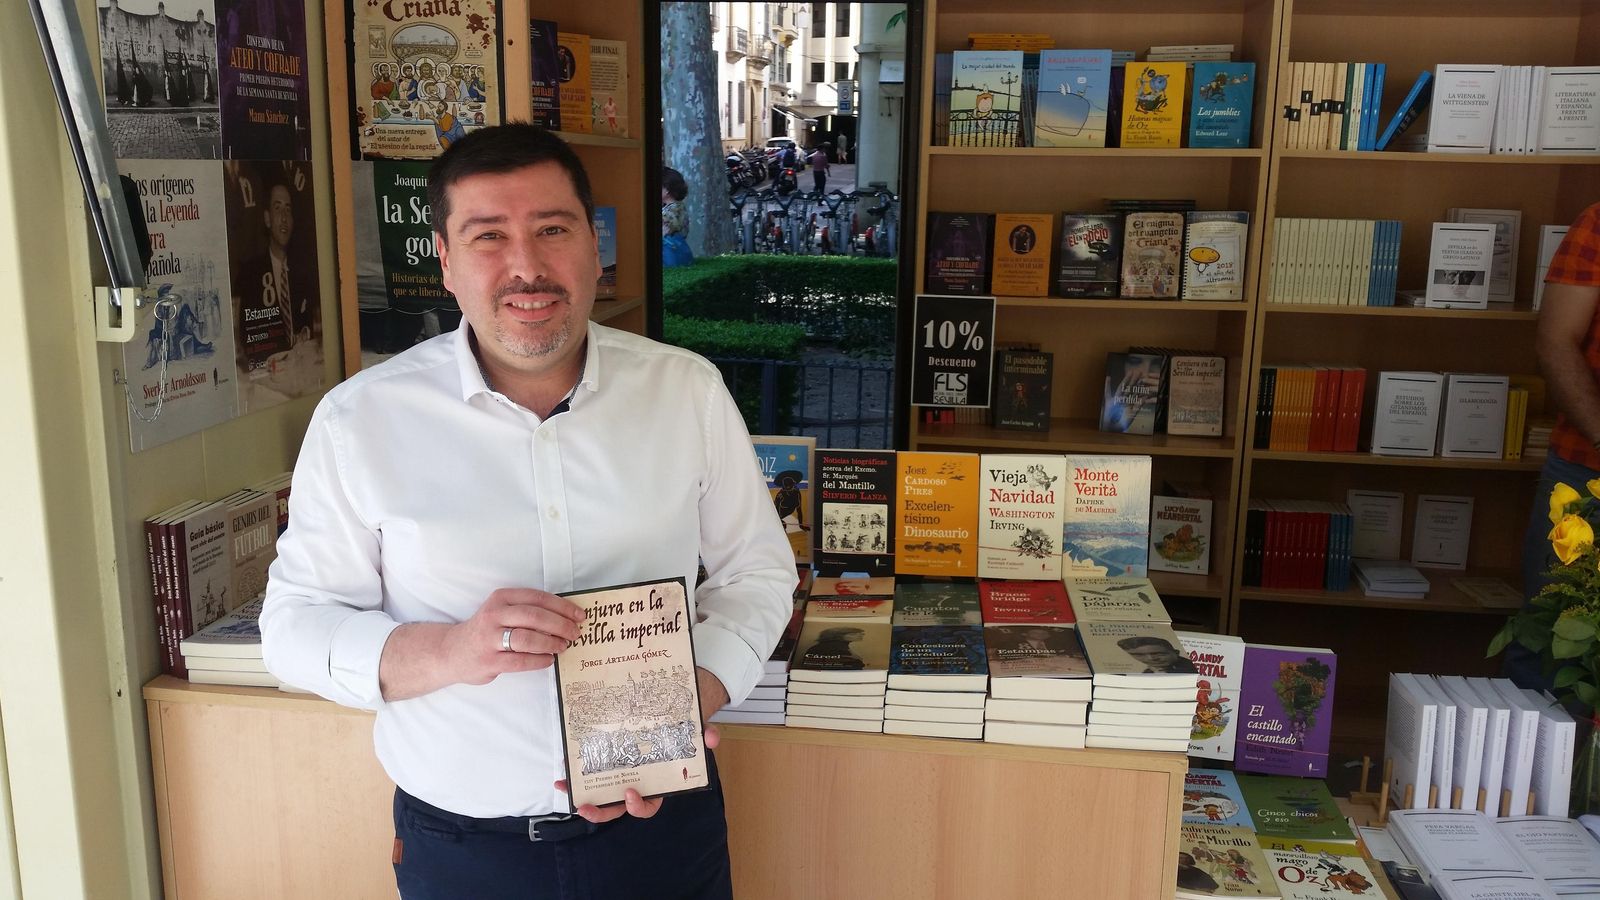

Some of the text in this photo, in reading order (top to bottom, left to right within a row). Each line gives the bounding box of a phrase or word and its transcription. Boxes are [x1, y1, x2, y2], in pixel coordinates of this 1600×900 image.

[230, 47, 254, 70] ATEO
[256, 49, 262, 71] Y
[264, 51, 301, 76] COFRADE
[249, 107, 289, 124] Manu Sánchez
[1197, 107, 1241, 118] Los jumblies
[150, 174, 195, 202] orígenes
[146, 199, 200, 228] la Leyenda
[383, 195, 404, 223] la
[1133, 220, 1175, 229] El enigma
[145, 252, 181, 284] pañola
[392, 272, 427, 284] Historias
[429, 274, 438, 285] de
[393, 287, 407, 298] que
[409, 288, 417, 296] se
[244, 306, 280, 321] Estampas
[923, 320, 984, 351] 10%
[928, 356, 977, 368] Descuento
[1005, 355, 1047, 366] El pasodoble
[1004, 365, 1047, 375] interminable
[143, 381, 168, 400] Sverkr
[170, 372, 207, 392] Arnoldsson
[935, 374, 967, 392] FLS
[1121, 384, 1150, 395] La niña
[934, 396, 966, 405] SEVILLA
[823, 456, 888, 466] Noticias biográficas
[905, 465, 927, 475] JOSÉ
[1074, 468, 1118, 481] Monte
[833, 472, 858, 481] Marqués
[904, 476, 947, 486] CARDOSO
[989, 469, 1027, 487] Vieja
[823, 481, 875, 490] del Mantillo
[904, 486, 932, 496] PIRES
[1074, 482, 1117, 496] Verità
[823, 490, 887, 500] SILVERIO LANZA
[989, 488, 1055, 505] Navidad
[904, 500, 955, 512] Excelen-
[1086, 506, 1117, 514] MAURIER
[232, 504, 272, 533] GENIOS DEL
[904, 513, 940, 525] tísimo
[989, 507, 1055, 519] WASHINGTON
[1157, 511, 1202, 523] NEANDERTAL
[989, 520, 1024, 531] IRVING
[904, 526, 969, 539] Dinosaurio
[234, 528, 272, 560] FÚTBOL
[583, 589, 663, 625] njura en la
[620, 611, 681, 649] imperial
[580, 648, 672, 671] JORGE ARTEAGA GÓMEZ
[1192, 663, 1227, 678] ERTAL
[1248, 704, 1265, 717] El
[1247, 720, 1283, 731] castillo
[1246, 733, 1297, 745] encantado
[1258, 809, 1319, 818] Cinco chicos
[1181, 826, 1231, 834] cubriendo
[1182, 832, 1204, 840] villa
[1206, 835, 1251, 847] Murillo
[1273, 852, 1319, 860] maravilloso
[1276, 857, 1309, 867] mago
[1278, 865, 1325, 886] Oz
